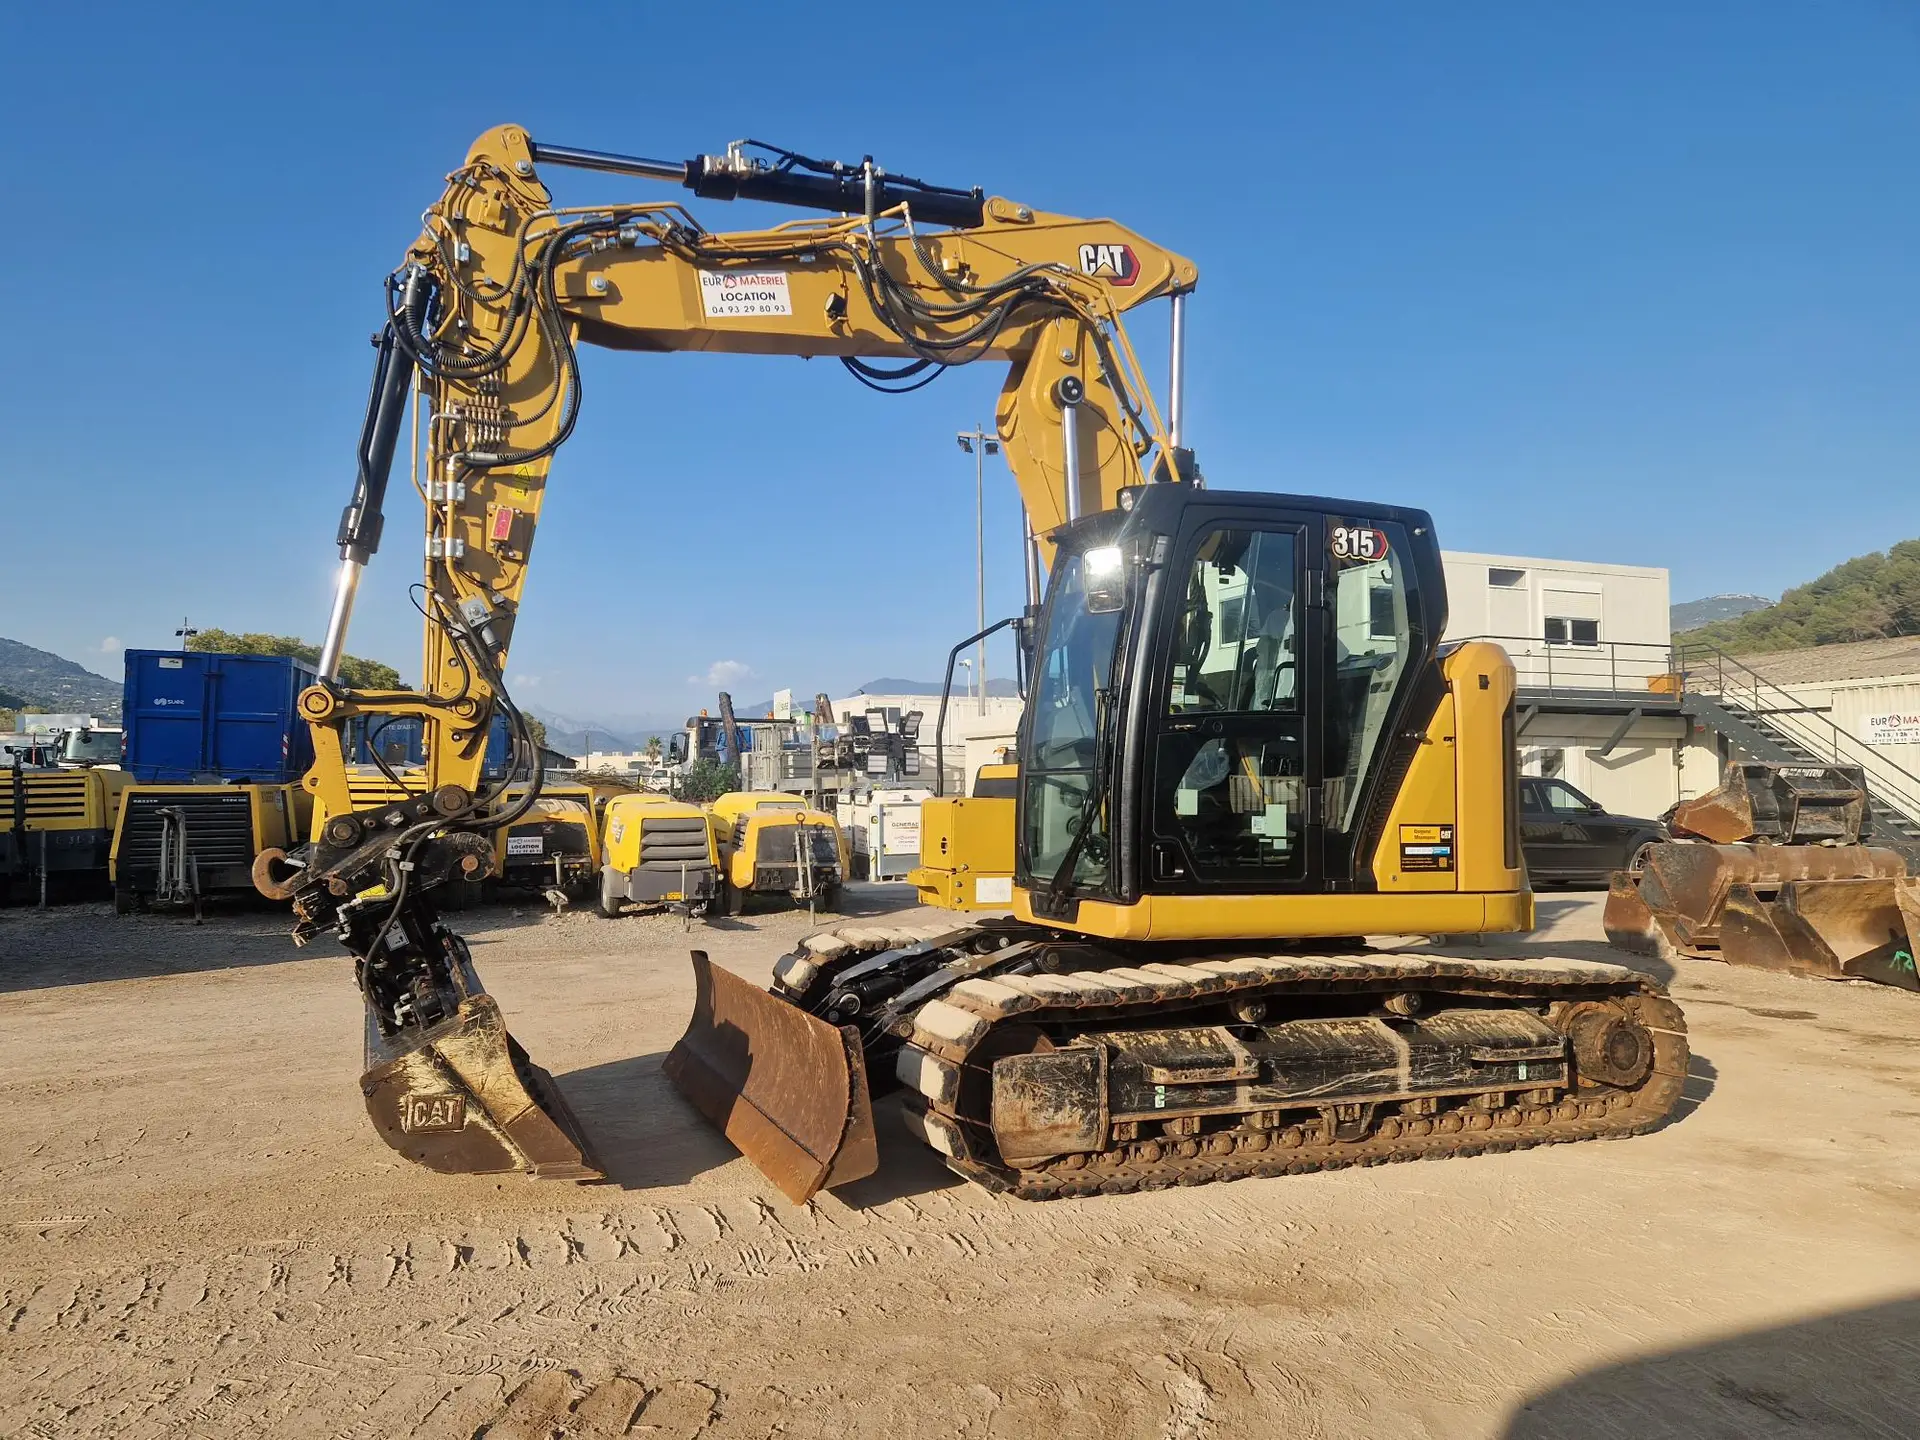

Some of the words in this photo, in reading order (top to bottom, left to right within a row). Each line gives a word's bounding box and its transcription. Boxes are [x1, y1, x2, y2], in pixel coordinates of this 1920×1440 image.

[1079, 244, 1124, 277] CAT
[739, 275, 785, 286] MATERIEL
[720, 291, 777, 302] LOCATION
[711, 306, 724, 314] 04
[727, 305, 740, 313] 93
[744, 305, 756, 313] 29
[759, 304, 771, 312] 80
[774, 304, 786, 312] 93
[1333, 526, 1375, 558] 315
[1903, 715, 1920, 725] MA
[413, 1100, 457, 1127] CAT
